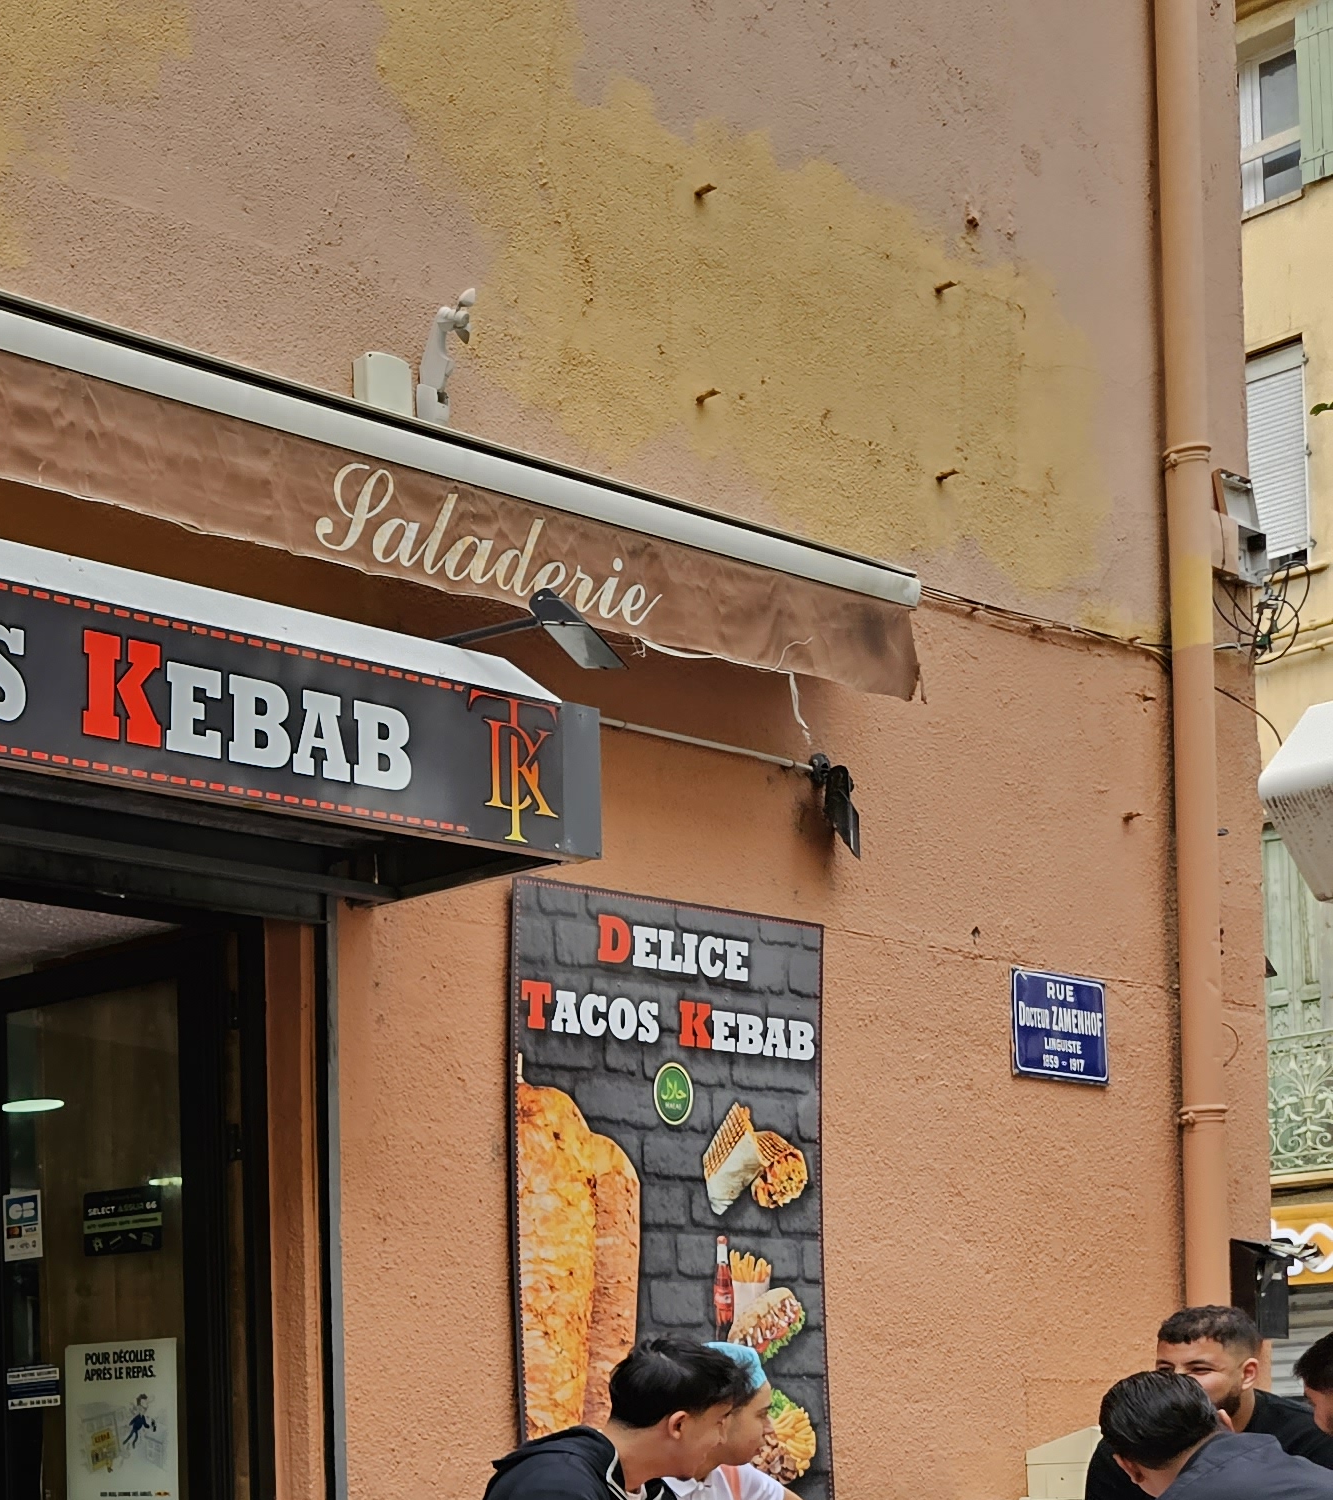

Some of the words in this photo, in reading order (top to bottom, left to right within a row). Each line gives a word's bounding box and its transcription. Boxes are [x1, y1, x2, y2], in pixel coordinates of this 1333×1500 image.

[315, 462, 663, 627] Saladerie
[82, 629, 413, 791] KEBAB
[597, 915, 750, 983] DELICE
[1046, 982, 1075, 1002] RUE
[521, 980, 660, 1044] TACOS
[678, 1001, 816, 1061] KEBAB
[1018, 1001, 1050, 1029] DOCTEUR
[1052, 1006, 1103, 1037] ZAMENHOF
[1044, 1037, 1082, 1055] LINGUISTE
[1069, 1058, 1085, 1072] 1917
[87, 1205, 115, 1217] SELECT
[145, 1200, 158, 1210] 66
[84, 1351, 111, 1366] POUR
[112, 1348, 156, 1364] DÉCOLLER
[114, 1366, 124, 1380] LE
[125, 1365, 157, 1379] REPAS.
